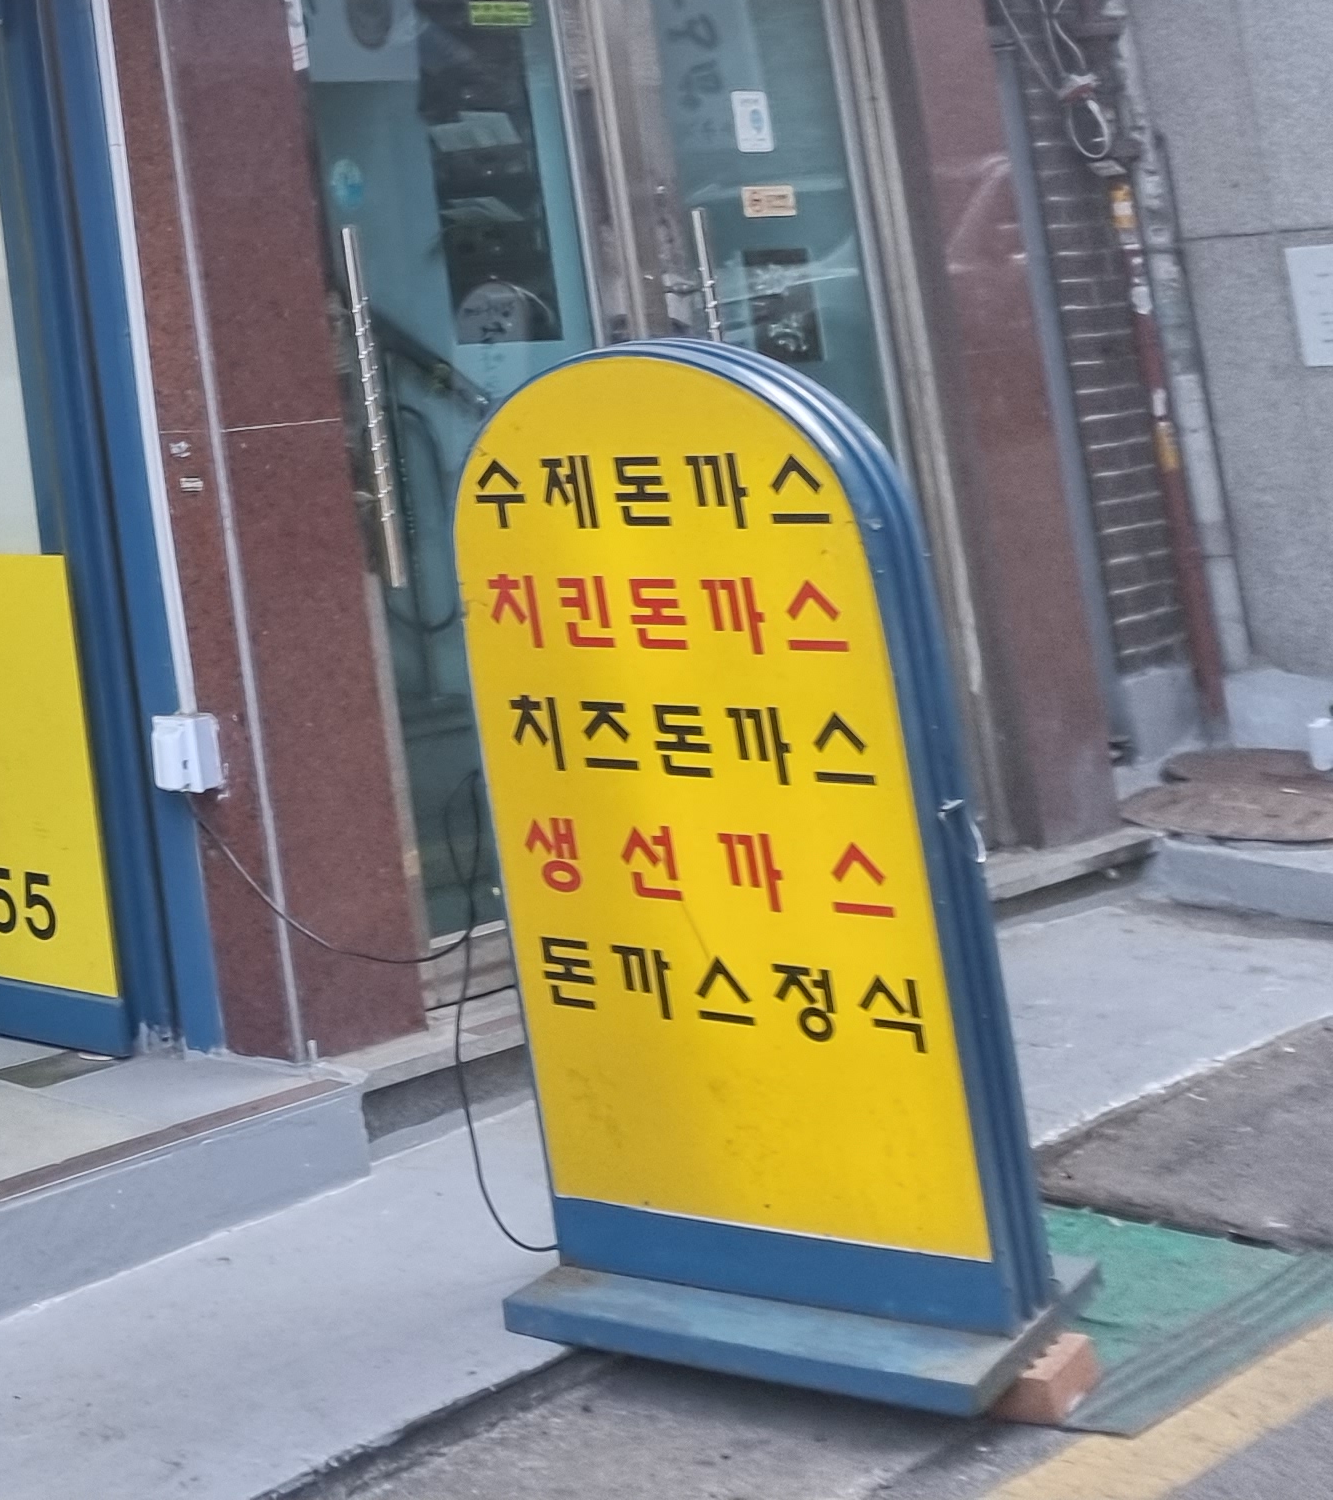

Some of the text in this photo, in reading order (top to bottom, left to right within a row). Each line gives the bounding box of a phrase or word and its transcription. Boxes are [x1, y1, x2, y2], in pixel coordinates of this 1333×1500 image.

[475, 454, 833, 529] 수제돈까스
[487, 573, 850, 655] 치킨돈까스
[509, 694, 877, 785] 치즈돈까스
[540, 936, 928, 1053] 돈까스정식
